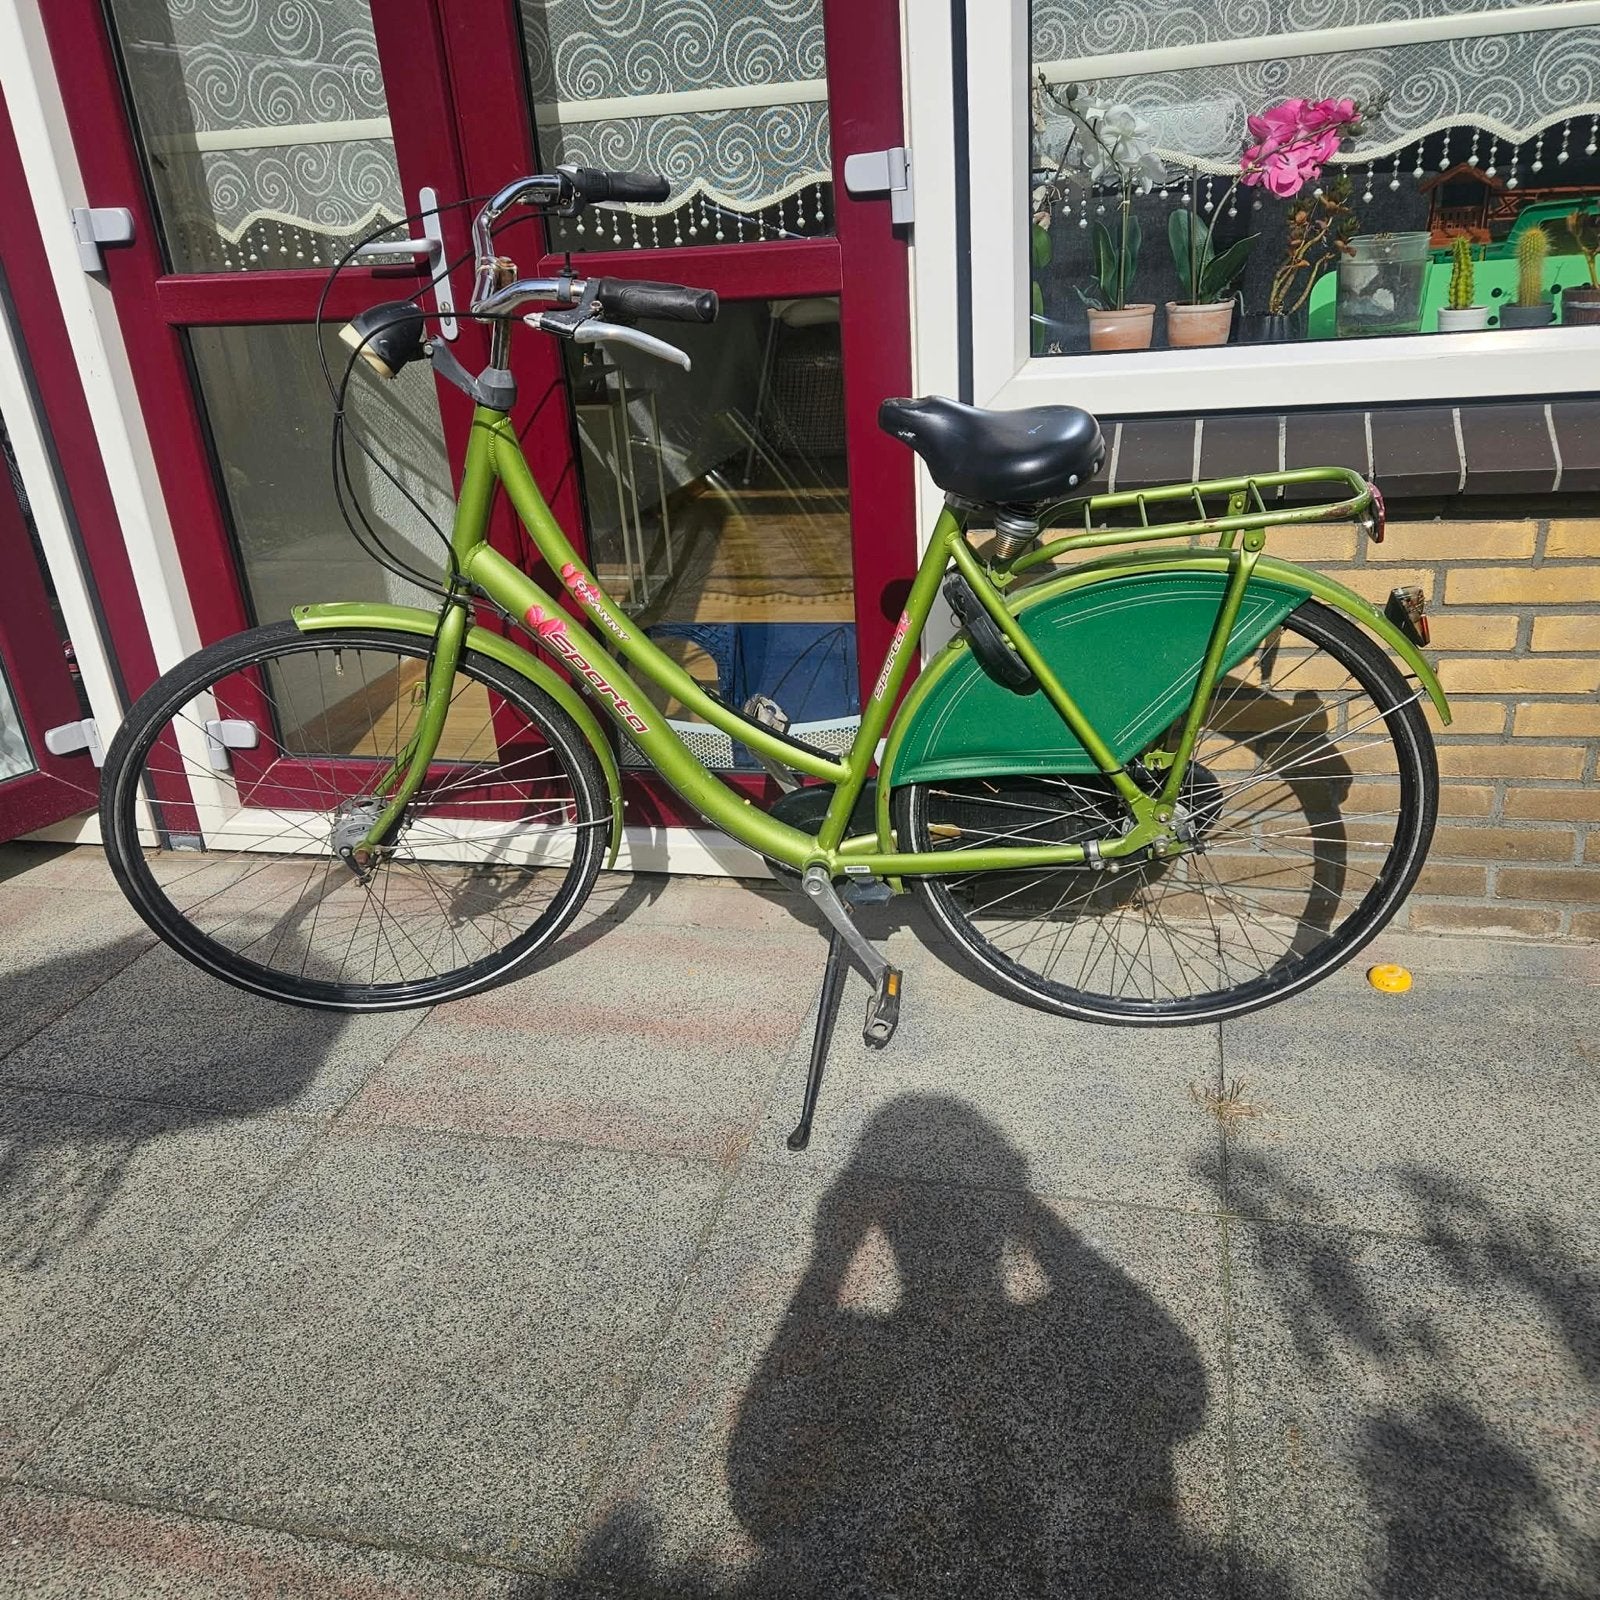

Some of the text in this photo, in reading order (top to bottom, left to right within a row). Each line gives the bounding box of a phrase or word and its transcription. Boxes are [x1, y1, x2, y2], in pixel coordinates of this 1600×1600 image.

[575, 579, 632, 641] GRANNY
[543, 631, 650, 734] Sparta
[874, 628, 906, 702] Sparta
